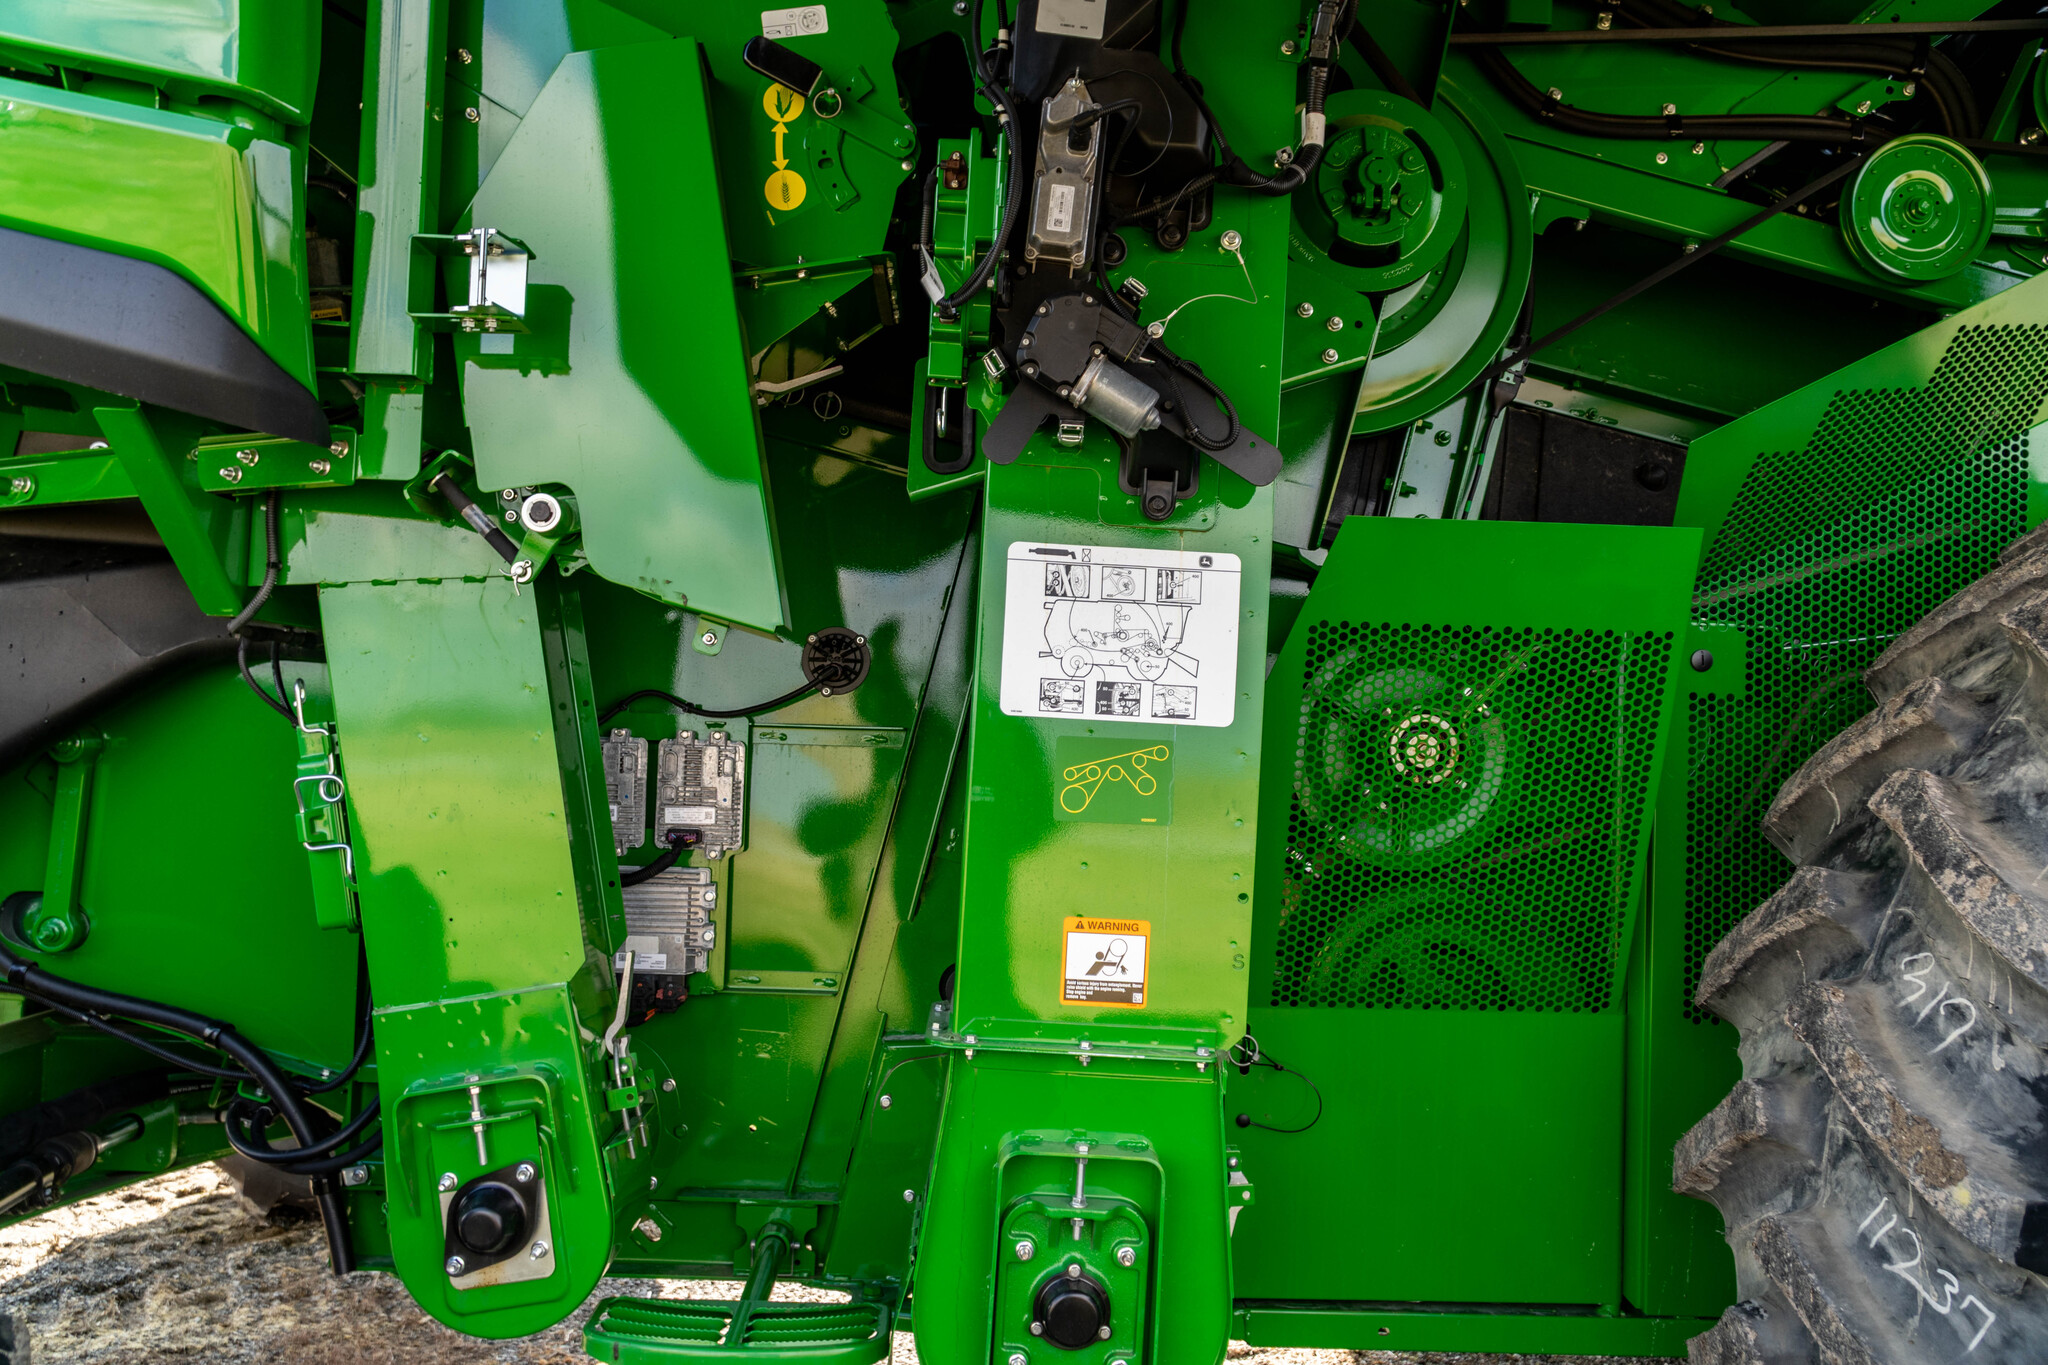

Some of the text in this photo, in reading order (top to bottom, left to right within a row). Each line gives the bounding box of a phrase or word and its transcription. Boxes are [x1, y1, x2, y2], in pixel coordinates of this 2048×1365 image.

[1088, 921, 1139, 932] WARNING
[1232, 953, 1245, 971] S
[1857, 1197, 1996, 1351] 11237
